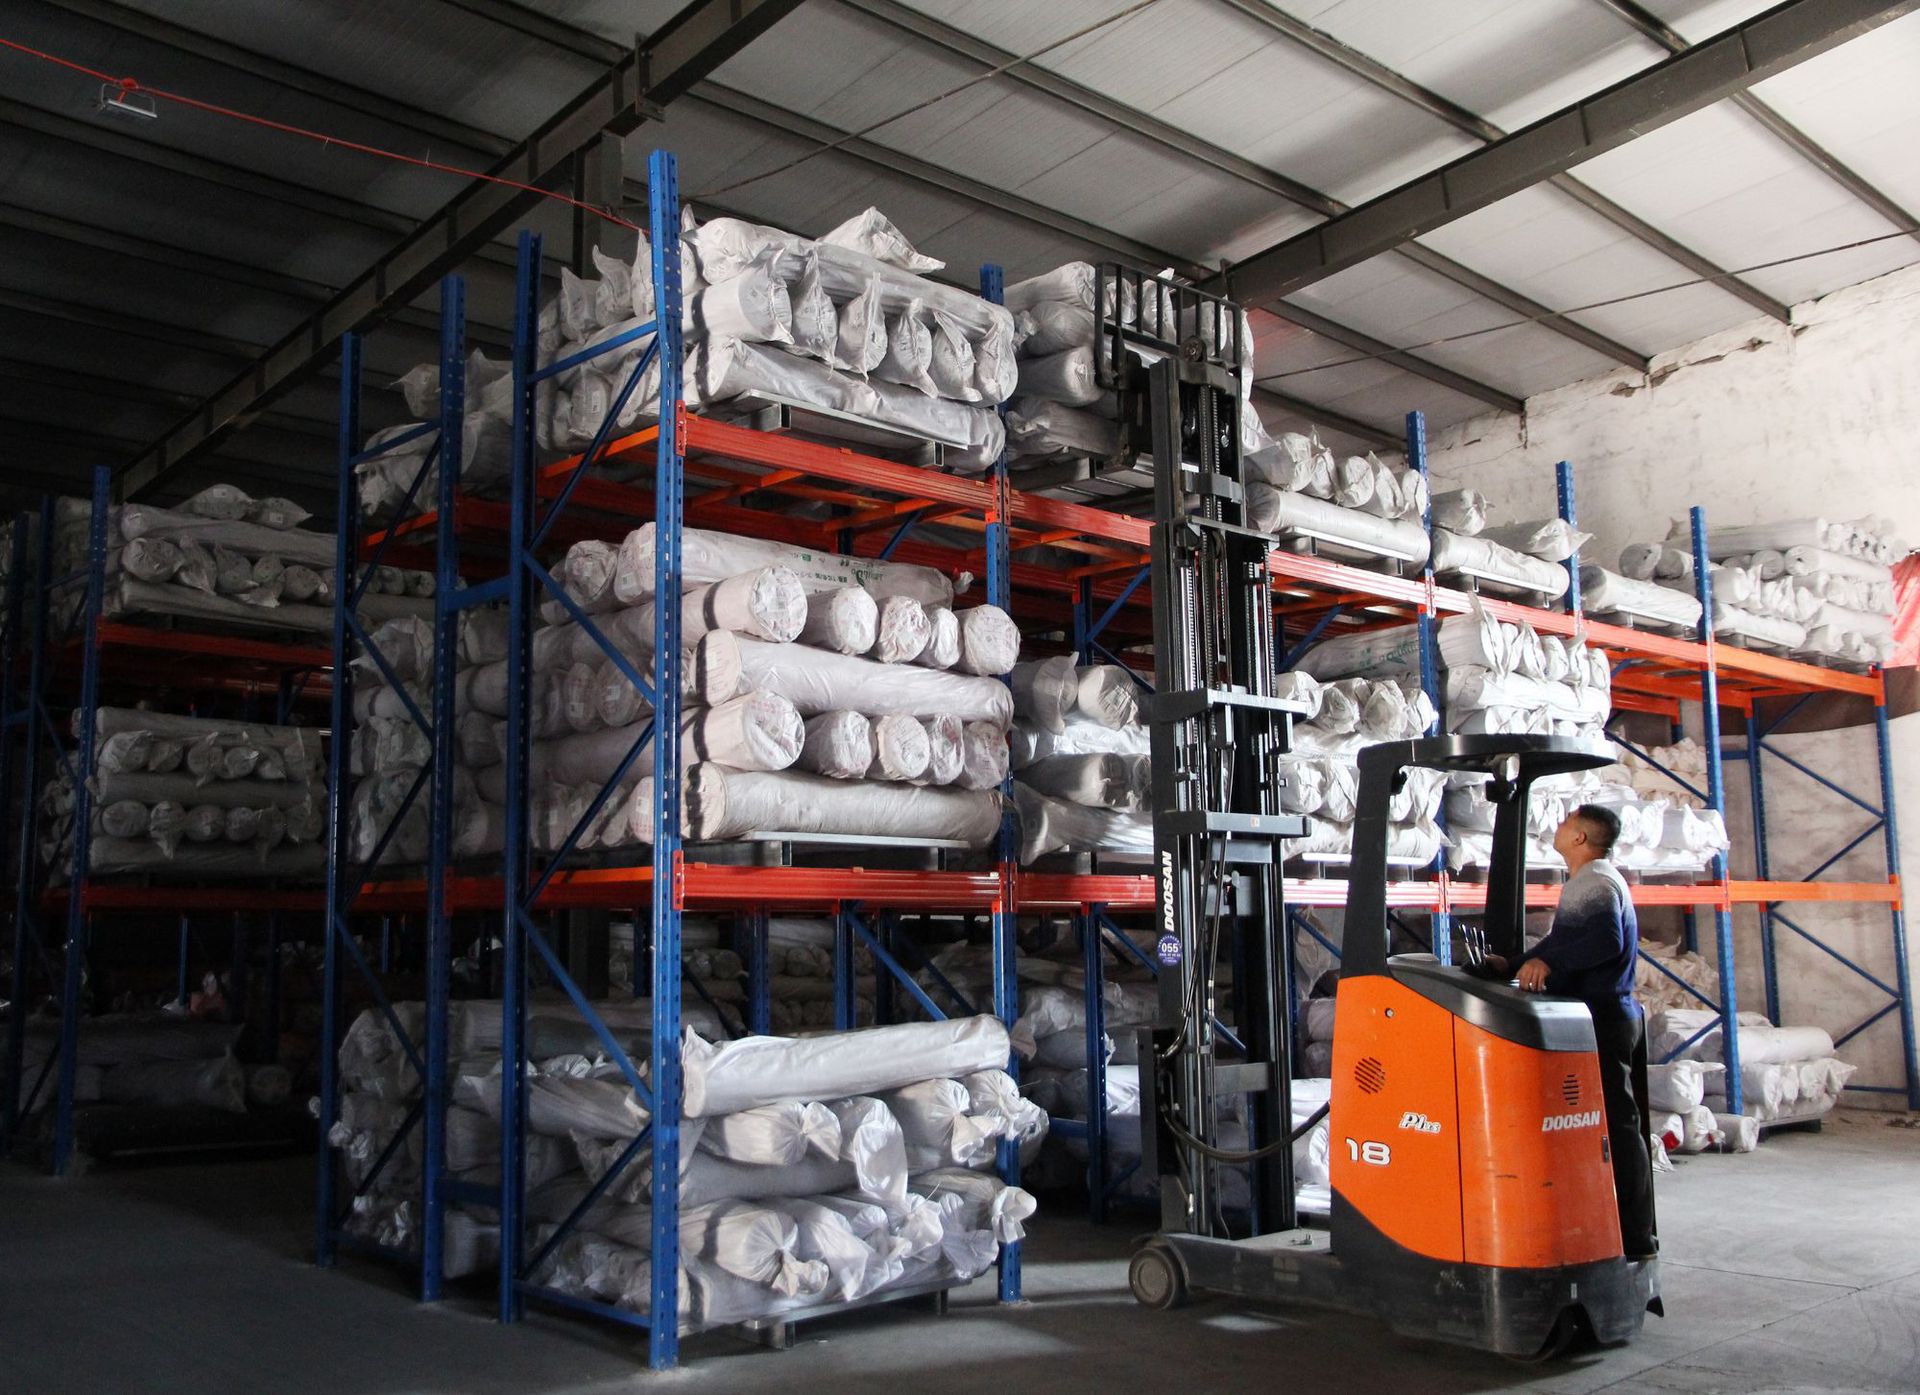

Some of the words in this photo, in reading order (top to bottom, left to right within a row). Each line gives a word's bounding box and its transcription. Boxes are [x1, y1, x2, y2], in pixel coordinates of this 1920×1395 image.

[1162, 850, 1174, 931] DOOSAN
[1161, 943, 1179, 953] 055
[1399, 1111, 1441, 1134] Plus
[1541, 1110, 1601, 1132] DOOSAN
[1345, 1137, 1391, 1166] 18
